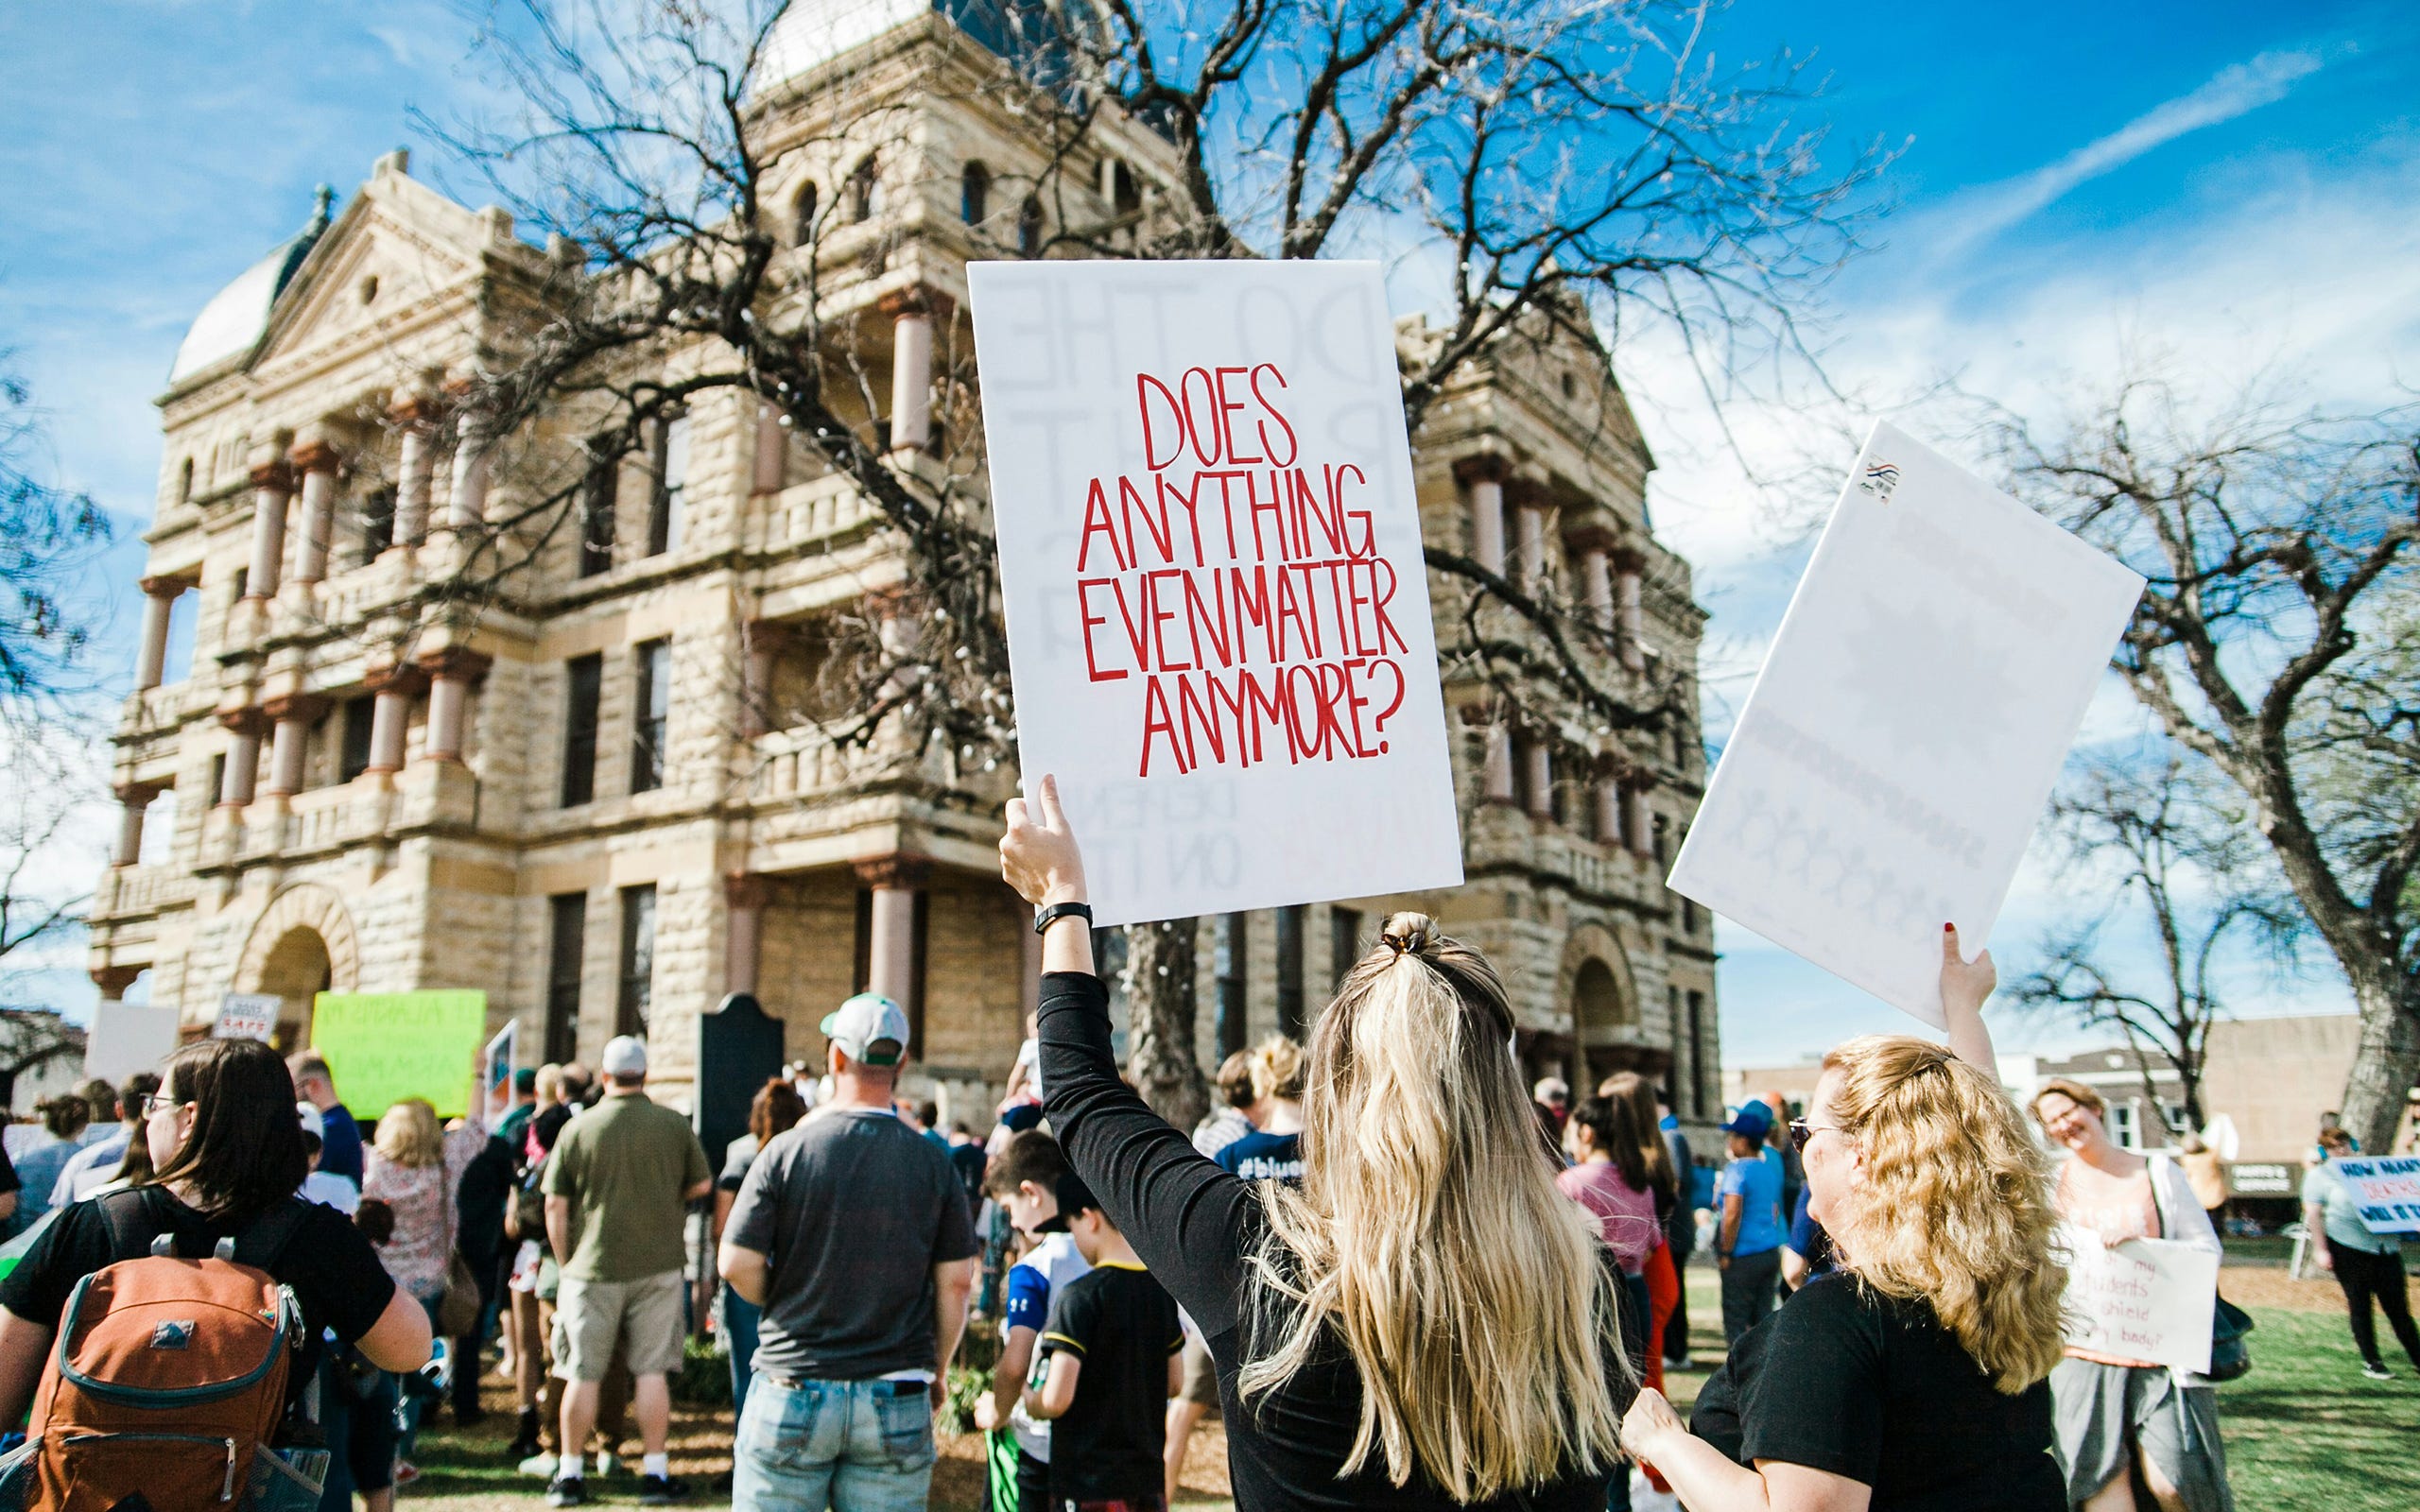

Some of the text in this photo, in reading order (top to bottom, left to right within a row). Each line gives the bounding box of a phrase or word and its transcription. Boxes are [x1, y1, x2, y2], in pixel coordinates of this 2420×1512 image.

[1137, 363, 1297, 471] DOES
[1077, 463, 1373, 573] ANYTHING
[1078, 558, 1409, 682] EVEN MATTER
[1139, 659, 1406, 778] ANYMORE?
[2341, 1162, 2376, 1177] HOW
